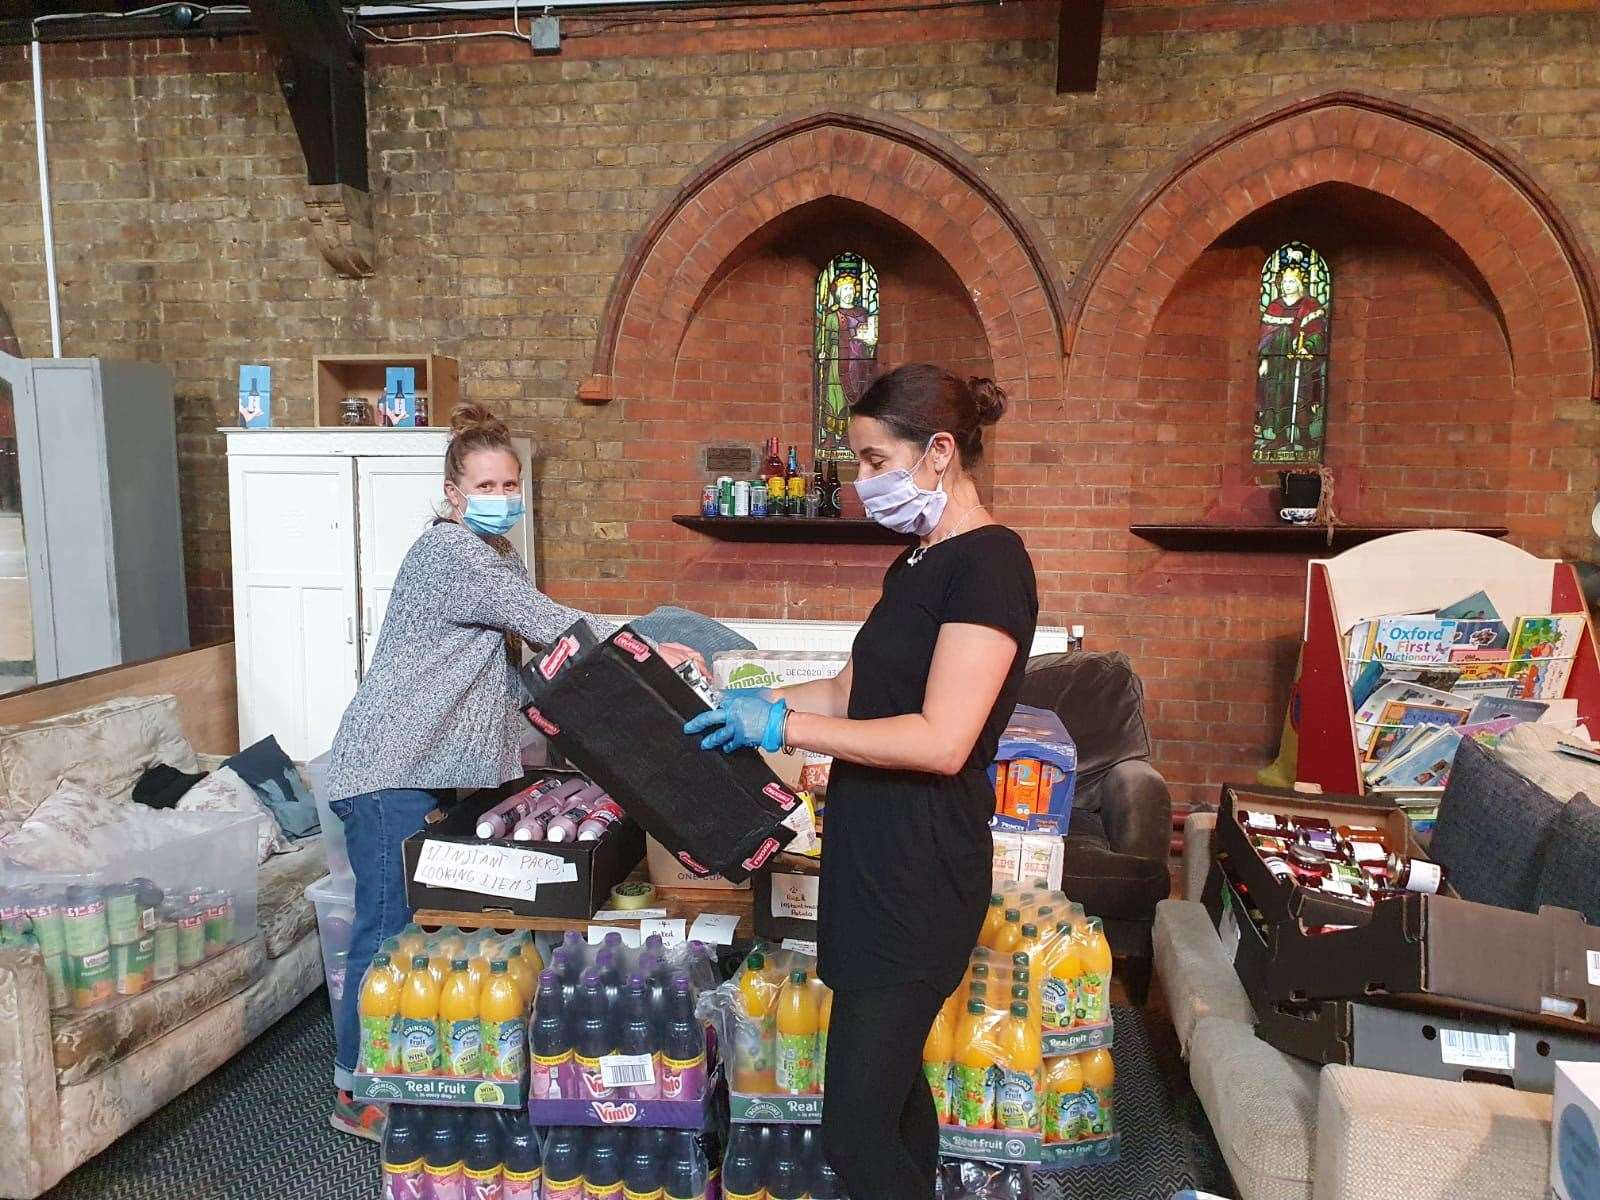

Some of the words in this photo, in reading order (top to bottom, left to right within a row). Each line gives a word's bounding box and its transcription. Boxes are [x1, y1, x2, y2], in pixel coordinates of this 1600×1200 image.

[1390, 627, 1444, 641] Oxford
[1397, 641, 1431, 653] First
[1385, 652, 1438, 663] Dictionary
[421, 864, 475, 883] COOKING
[368, 1082, 401, 1097] ROBINSONS
[405, 1080, 434, 1092] Real
[438, 1082, 467, 1095] Fruit
[594, 1102, 635, 1122] Vimto
[748, 1103, 780, 1117] ROBINSONS
[787, 1100, 817, 1112] Real
[979, 1138, 1003, 1150] Fruit
